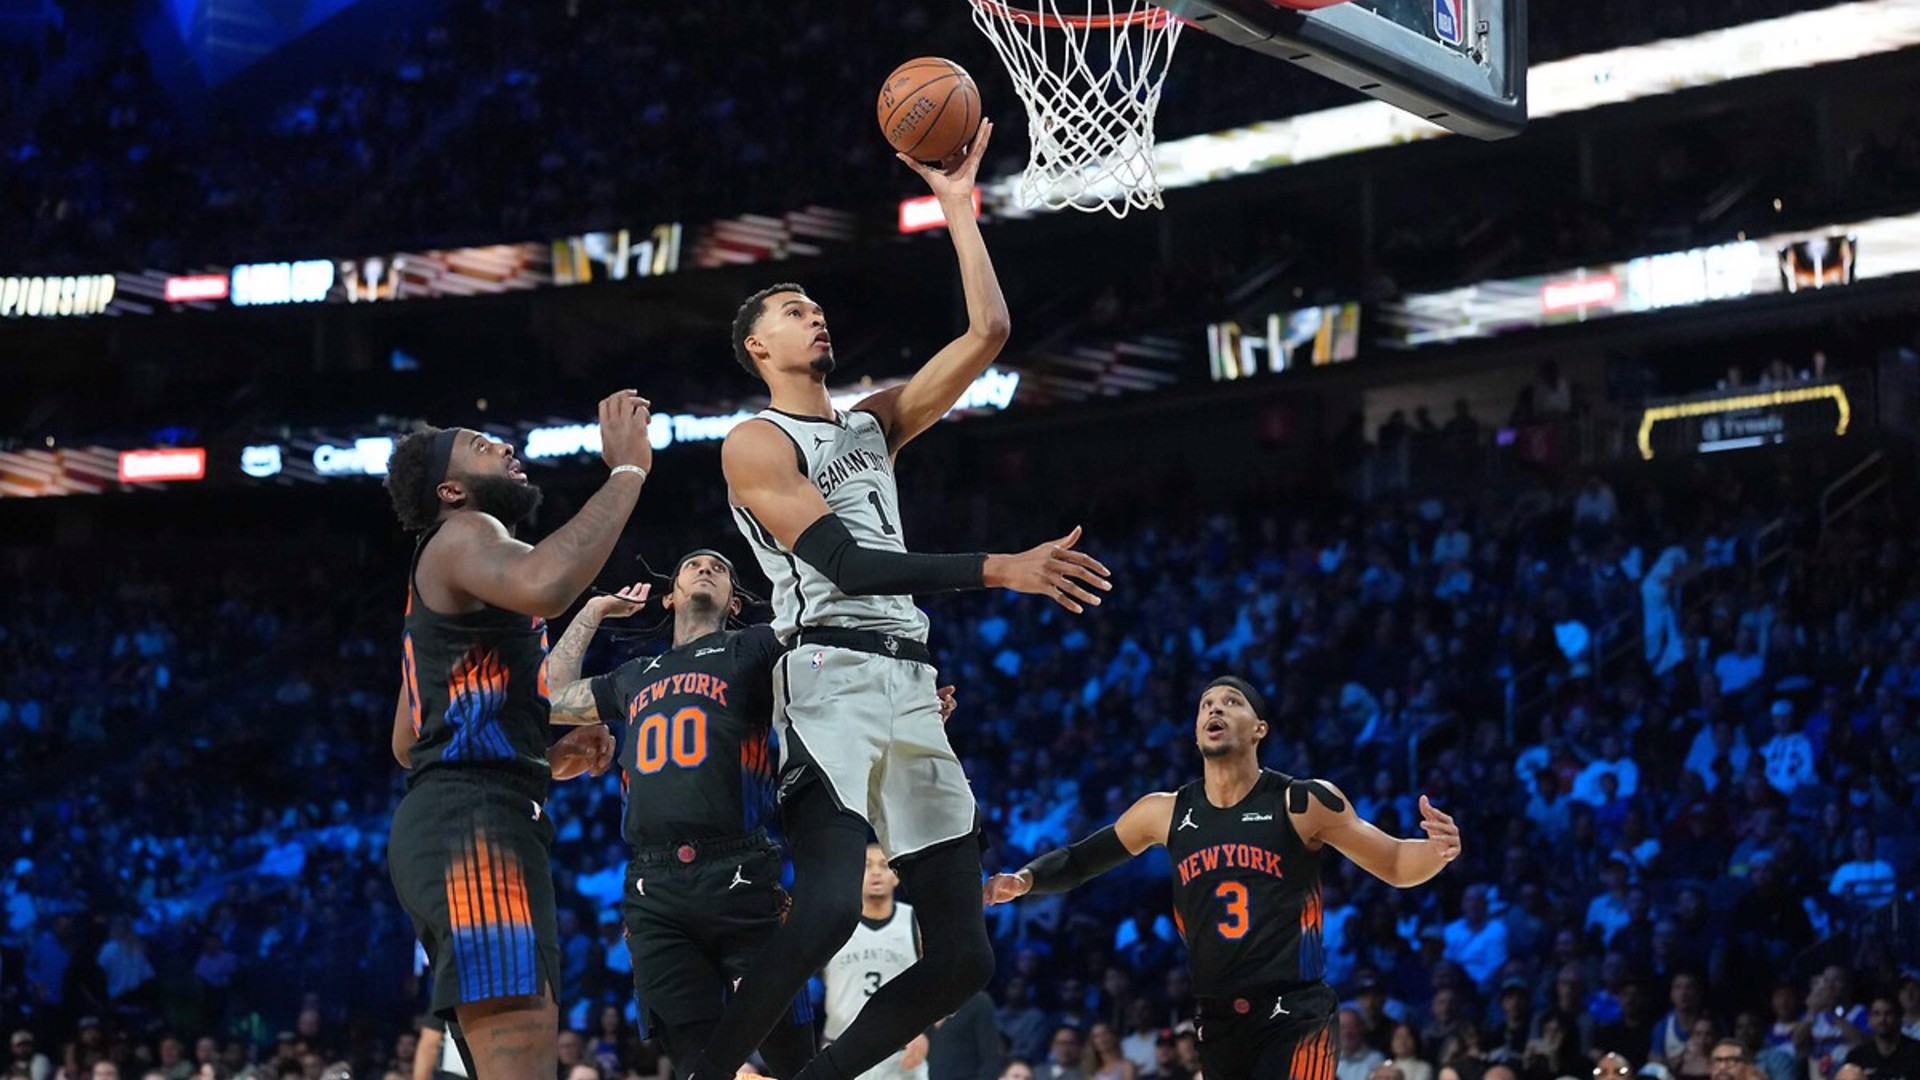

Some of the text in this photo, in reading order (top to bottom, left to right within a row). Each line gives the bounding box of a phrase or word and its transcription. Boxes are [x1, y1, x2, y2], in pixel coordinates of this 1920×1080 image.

[868, 491, 896, 535] 1
[629, 672, 728, 725] NEW YORK
[636, 704, 708, 775] 00
[1177, 844, 1283, 886] NEW YORK
[1215, 881, 1250, 940] 3
[864, 971, 881, 996] 3
